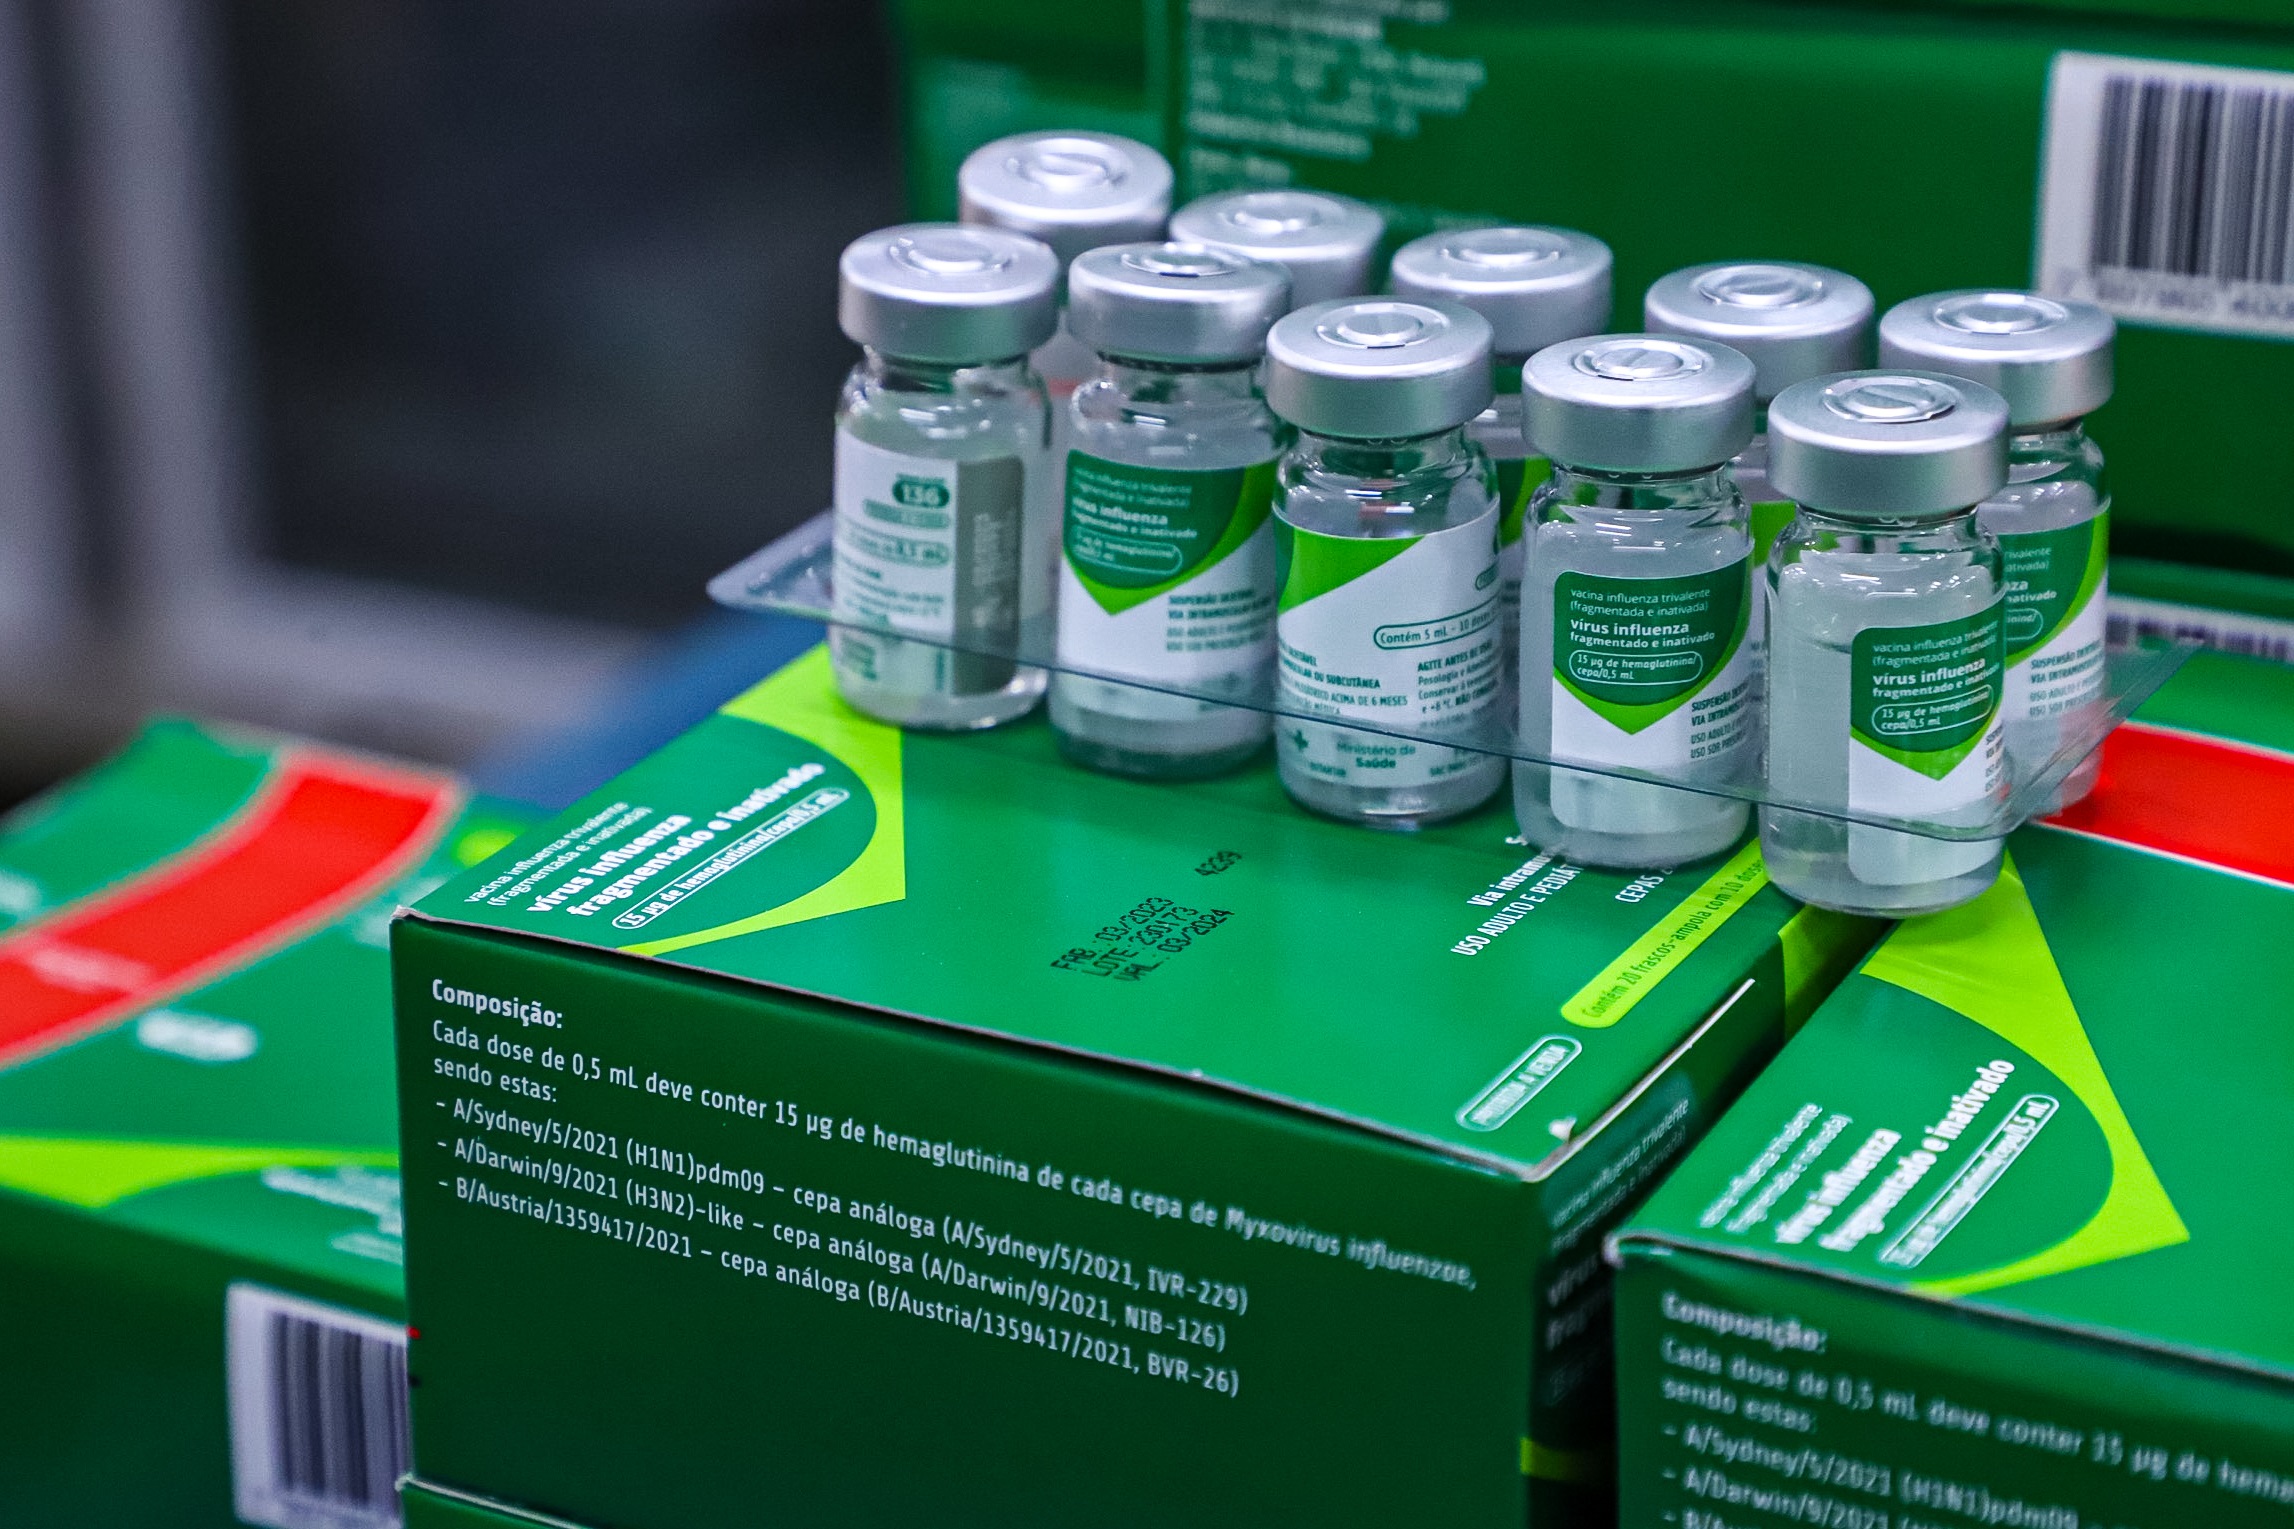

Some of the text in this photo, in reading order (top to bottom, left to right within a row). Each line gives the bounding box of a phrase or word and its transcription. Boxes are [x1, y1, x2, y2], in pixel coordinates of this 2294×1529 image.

[1100, 503, 1168, 525] influenza
[1570, 588, 1711, 604] vacina influenza trivalente
[1570, 601, 1708, 617] (fragmentada e inativada)
[1379, 629, 1421, 645] Contém
[1425, 628, 1431, 641] 5
[1434, 625, 1448, 639] mL
[1570, 618, 1690, 637] vírus influenza
[1570, 631, 1715, 648] fragmentado e inativado
[1873, 636, 1962, 653] vacina influenza
[1577, 653, 1588, 664] 15
[1606, 658, 1619, 668] de
[1620, 670, 1635, 680] mL
[1873, 650, 1959, 668] (fragmentada e
[1873, 658, 1986, 686] vírus influenza
[1380, 695, 1408, 706] MESES
[1873, 679, 1963, 700] fragmentado e
[1882, 709, 1894, 719] 15
[1914, 707, 1927, 716] de
[1355, 757, 1397, 769] Saúde
[566, 762, 826, 917] fragmentado e inativado
[464, 875, 513, 903] vacina
[505, 838, 571, 876] influenza
[487, 850, 580, 906] (fragmentada
[526, 814, 692, 913] vírus influenza
[619, 912, 646, 926] 15
[659, 883, 684, 902] de
[1466, 884, 1506, 907] Via
[1614, 874, 1666, 904] CEPAS
[1450, 934, 1491, 957] USO
[1476, 901, 1536, 938] ADULTO
[1519, 893, 1546, 904] E
[1582, 984, 1631, 1018] Contém
[1616, 967, 1643, 986] 20
[1630, 911, 1712, 974] frascos-ampola
[1705, 891, 1732, 911] com
[1720, 877, 1746, 894] 10
[432, 978, 563, 1029] Composição:
[433, 1057, 557, 1104] sendo estas:
[1924, 1059, 2015, 1141] inativado
[433, 1019, 480, 1050] Cada
[487, 1033, 534, 1064] dose
[541, 1046, 566, 1072] de
[572, 1052, 601, 1081] 0,5
[609, 1065, 639, 1090] mL
[645, 1071, 693, 1102] deve
[700, 1087, 767, 1119] conter
[775, 1099, 798, 1128] 15
[840, 1117, 866, 1144] de
[873, 1123, 1030, 1183] hemaglutinina
[1037, 1165, 1064, 1191] de
[1071, 1175, 1124, 1206] cada
[1130, 1188, 1183, 1219] cepa
[1189, 1200, 1219, 1228] de
[1224, 1206, 1341, 1257] Myxovirus
[1641, 1098, 1690, 1152] trivalente
[1921, 1135, 1950, 1152] e
[453, 1097, 1248, 1317] A/Sydney/5/2021 (H1N1)pdm09 cepa análoga (A/Sydney/5/2021, IVR-229)
[454, 1137, 1226, 1353] A/Darwin/9/2021 (H3N2)-like cepa análoga (A/Darwin/9/2021, NIB-126)
[456, 1176, 692, 1258] B/Austria/1359417/2021
[721, 1250, 768, 1277] cepa
[775, 1264, 860, 1302] análoga
[868, 1279, 1140, 1375] (B/Austria/1359417/2021,
[1147, 1351, 1240, 1399] BVR-26)
[1661, 1290, 1828, 1353] Composição:
[1661, 1377, 1738, 1415] sendo
[1661, 1334, 1722, 1376] Cada
[1728, 1354, 1789, 1391] dose
[1797, 1368, 1828, 1400] de
[1833, 1376, 1874, 1411] 0,5
[1926, 1395, 1991, 1437] deve
[1996, 1415, 2084, 1456] conter
[2174, 1449, 2211, 1485] de
